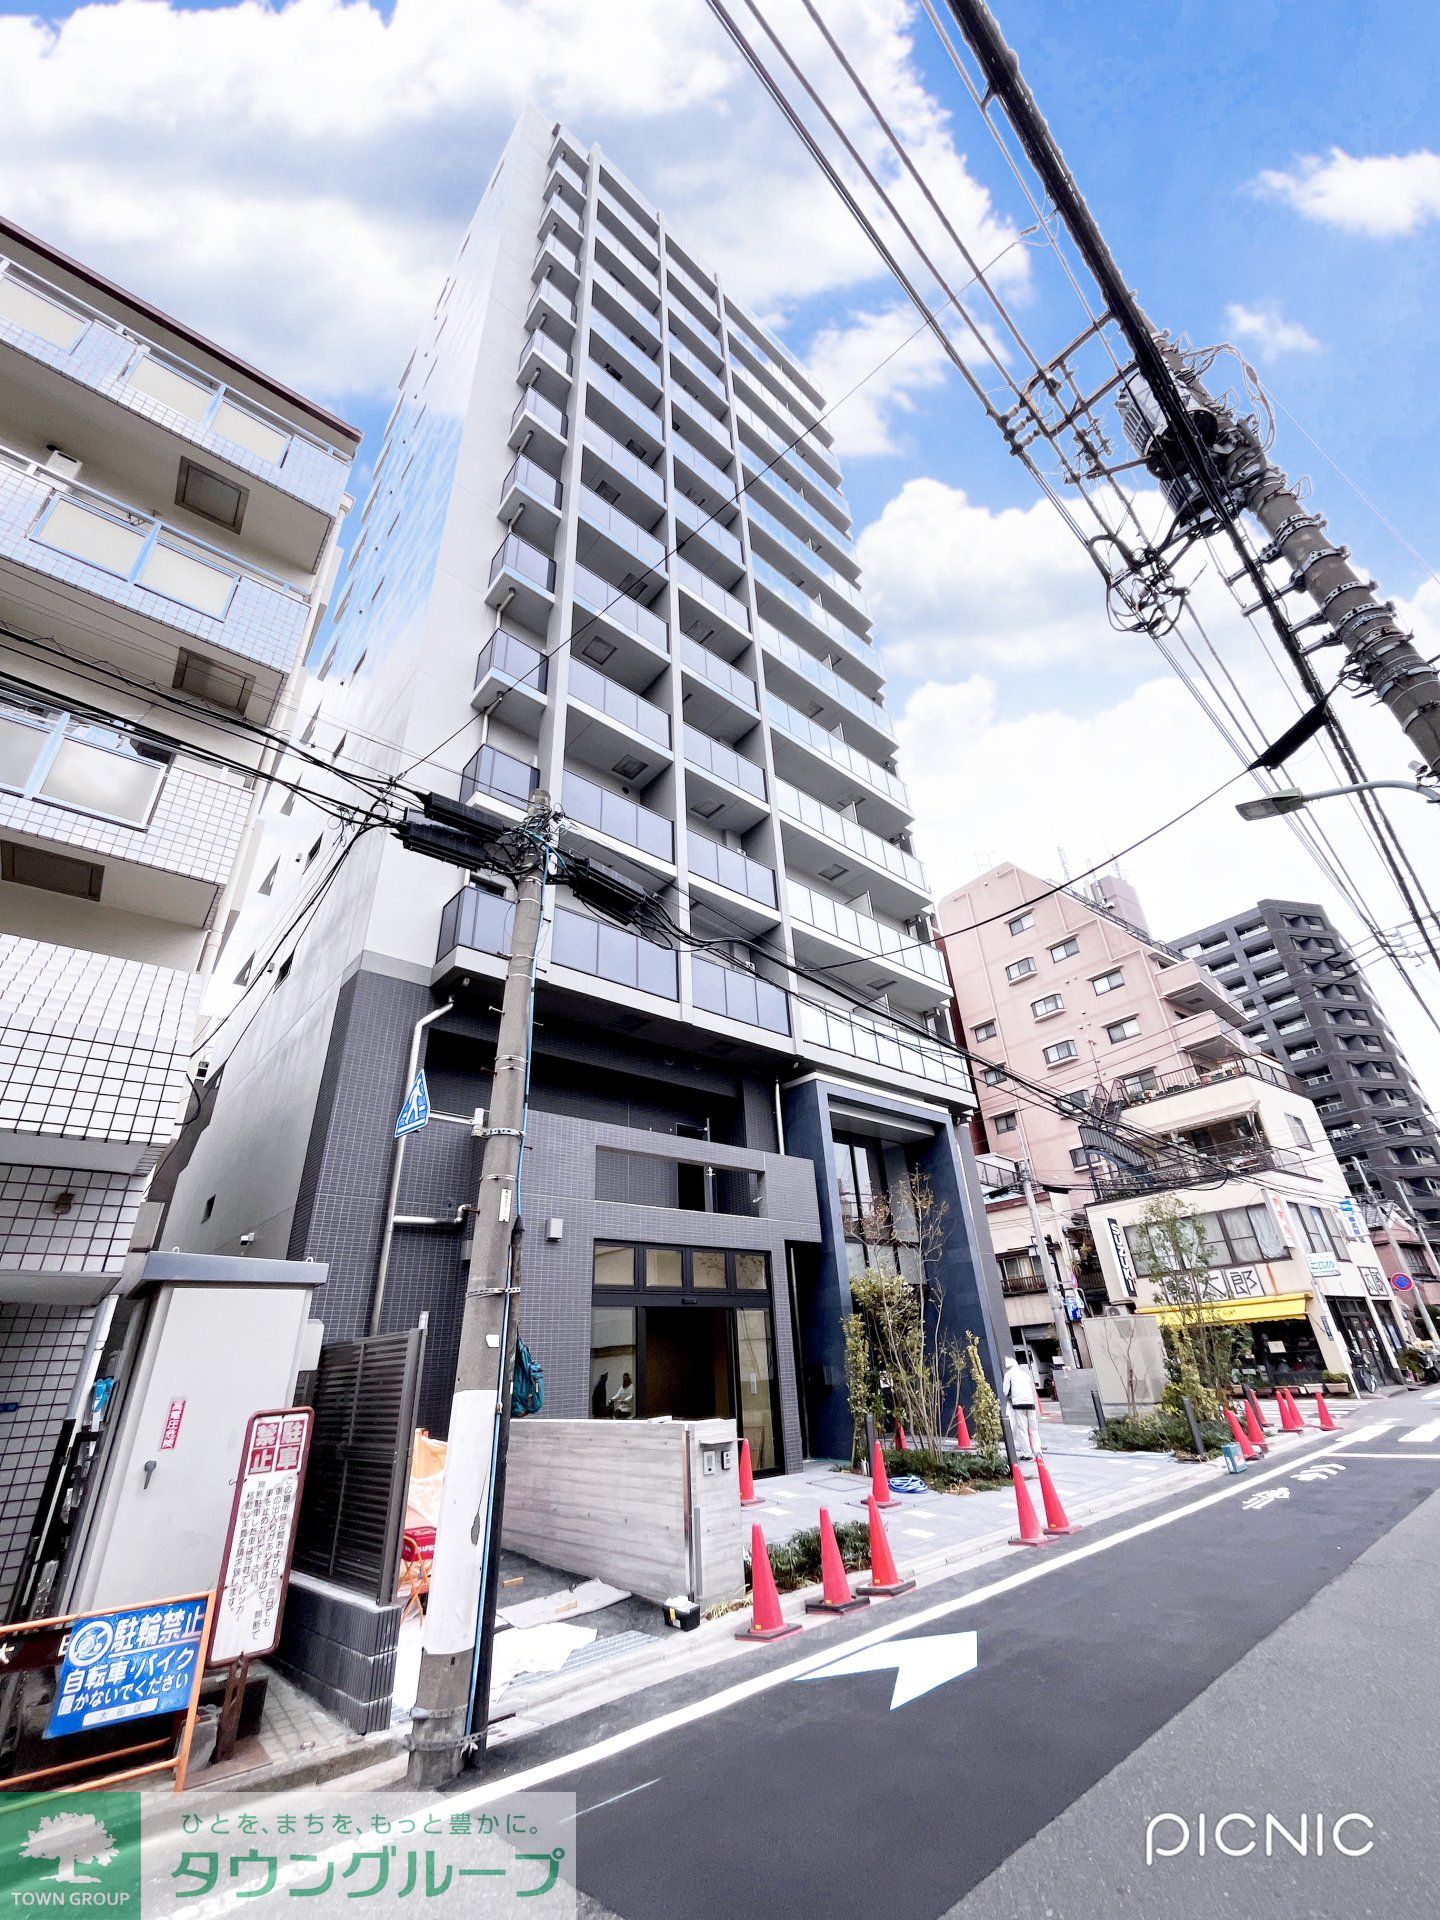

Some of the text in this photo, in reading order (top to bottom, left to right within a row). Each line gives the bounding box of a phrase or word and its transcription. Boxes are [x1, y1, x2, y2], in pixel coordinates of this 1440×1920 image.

[1110, 1223, 1136, 1294] SUZUKI
[250, 1424, 278, 1473] 禁止
[276, 1421, 304, 1470] 駐車
[110, 1606, 205, 1652] 駐輪禁止
[57, 1672, 189, 1716] 置かないでください
[62, 1647, 195, 1695] 自転車・バイク
